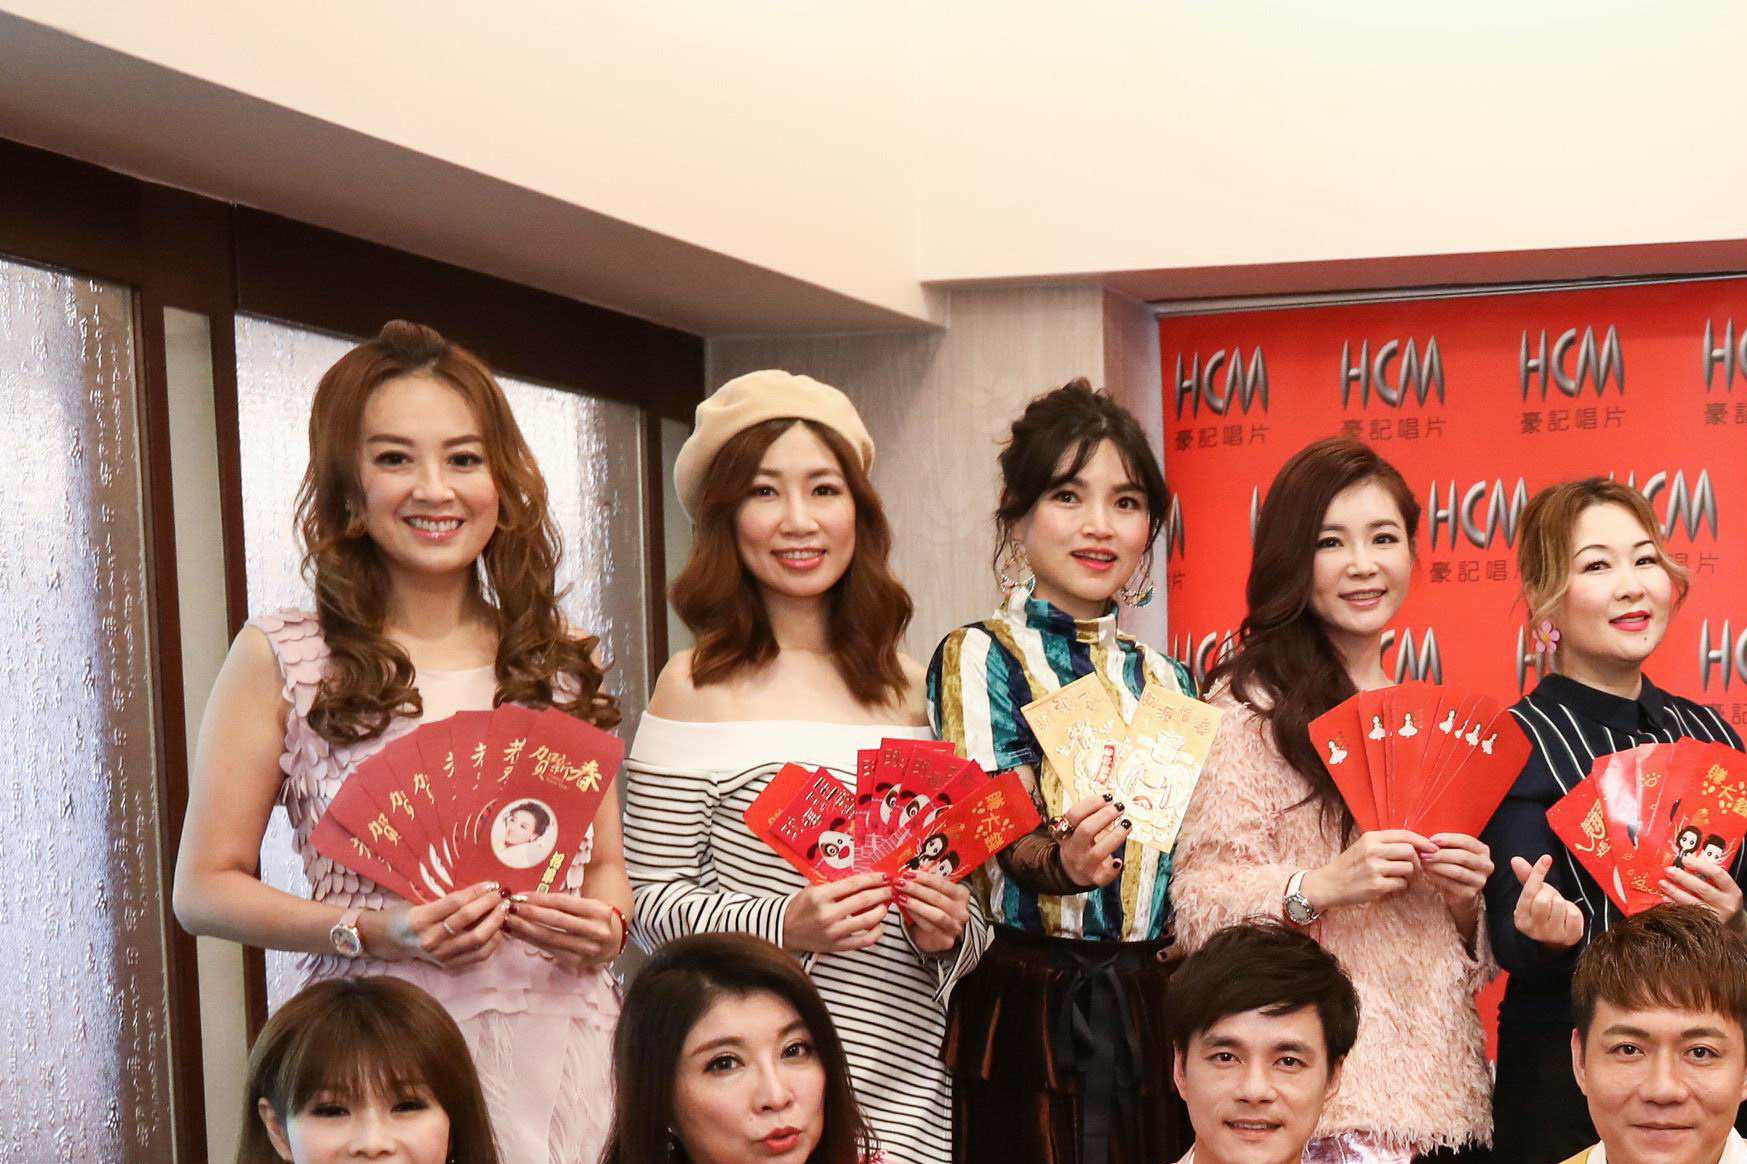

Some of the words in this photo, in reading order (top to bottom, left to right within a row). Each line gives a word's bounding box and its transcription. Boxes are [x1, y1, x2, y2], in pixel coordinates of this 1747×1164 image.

[1174, 345, 1270, 421] HCM
[1340, 335, 1445, 410] HCM
[1519, 324, 1625, 404] HCM
[1174, 423, 1270, 451] 豪記唱片
[1520, 406, 1626, 434] 豪記唱片
[1429, 559, 1520, 584] 豪記唱
